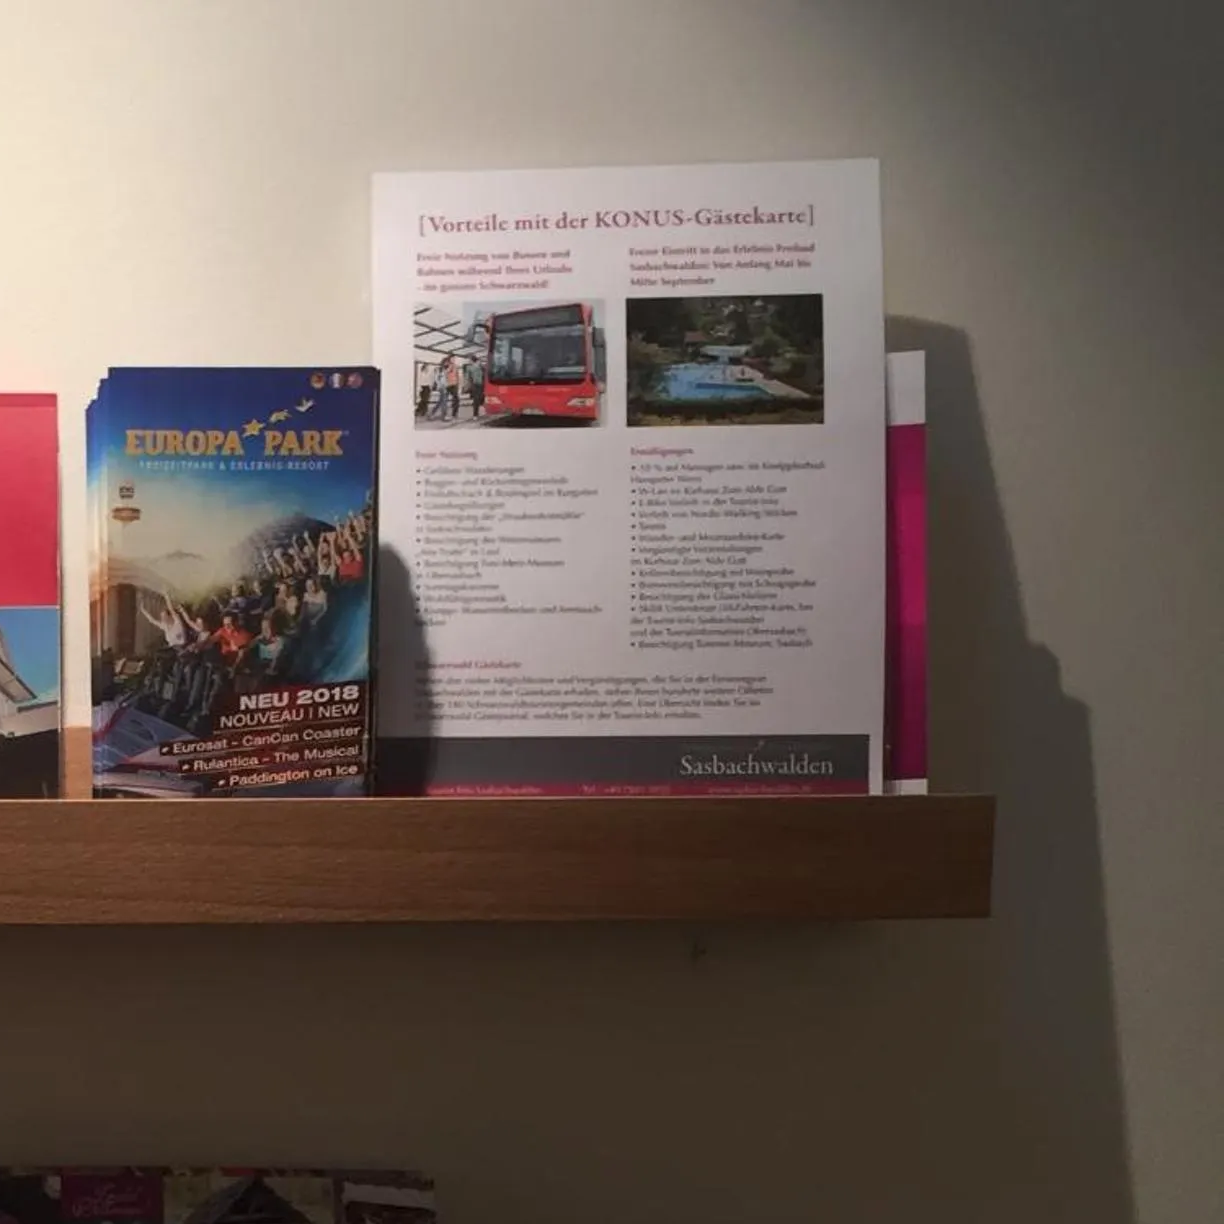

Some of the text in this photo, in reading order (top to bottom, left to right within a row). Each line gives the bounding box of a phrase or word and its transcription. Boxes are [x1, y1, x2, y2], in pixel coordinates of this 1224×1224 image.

[514, 213, 549, 231] mit
[555, 211, 589, 230] der
[595, 204, 815, 229] KONUS-Gästekarte]
[551, 249, 571, 258] und
[124, 428, 345, 456] EUROPA PARK
[239, 684, 360, 712] NEU 2018
[219, 702, 360, 730] NOUVEAU NEW
[172, 738, 229, 755] Eurosat
[241, 731, 300, 748] CanCan
[302, 724, 362, 741] Coaster
[192, 755, 259, 773] Rulantica
[274, 750, 300, 764] The
[303, 745, 360, 761] Musical
[679, 752, 834, 777] Sasbachwalden
[228, 764, 359, 788] Paddington on Ice
